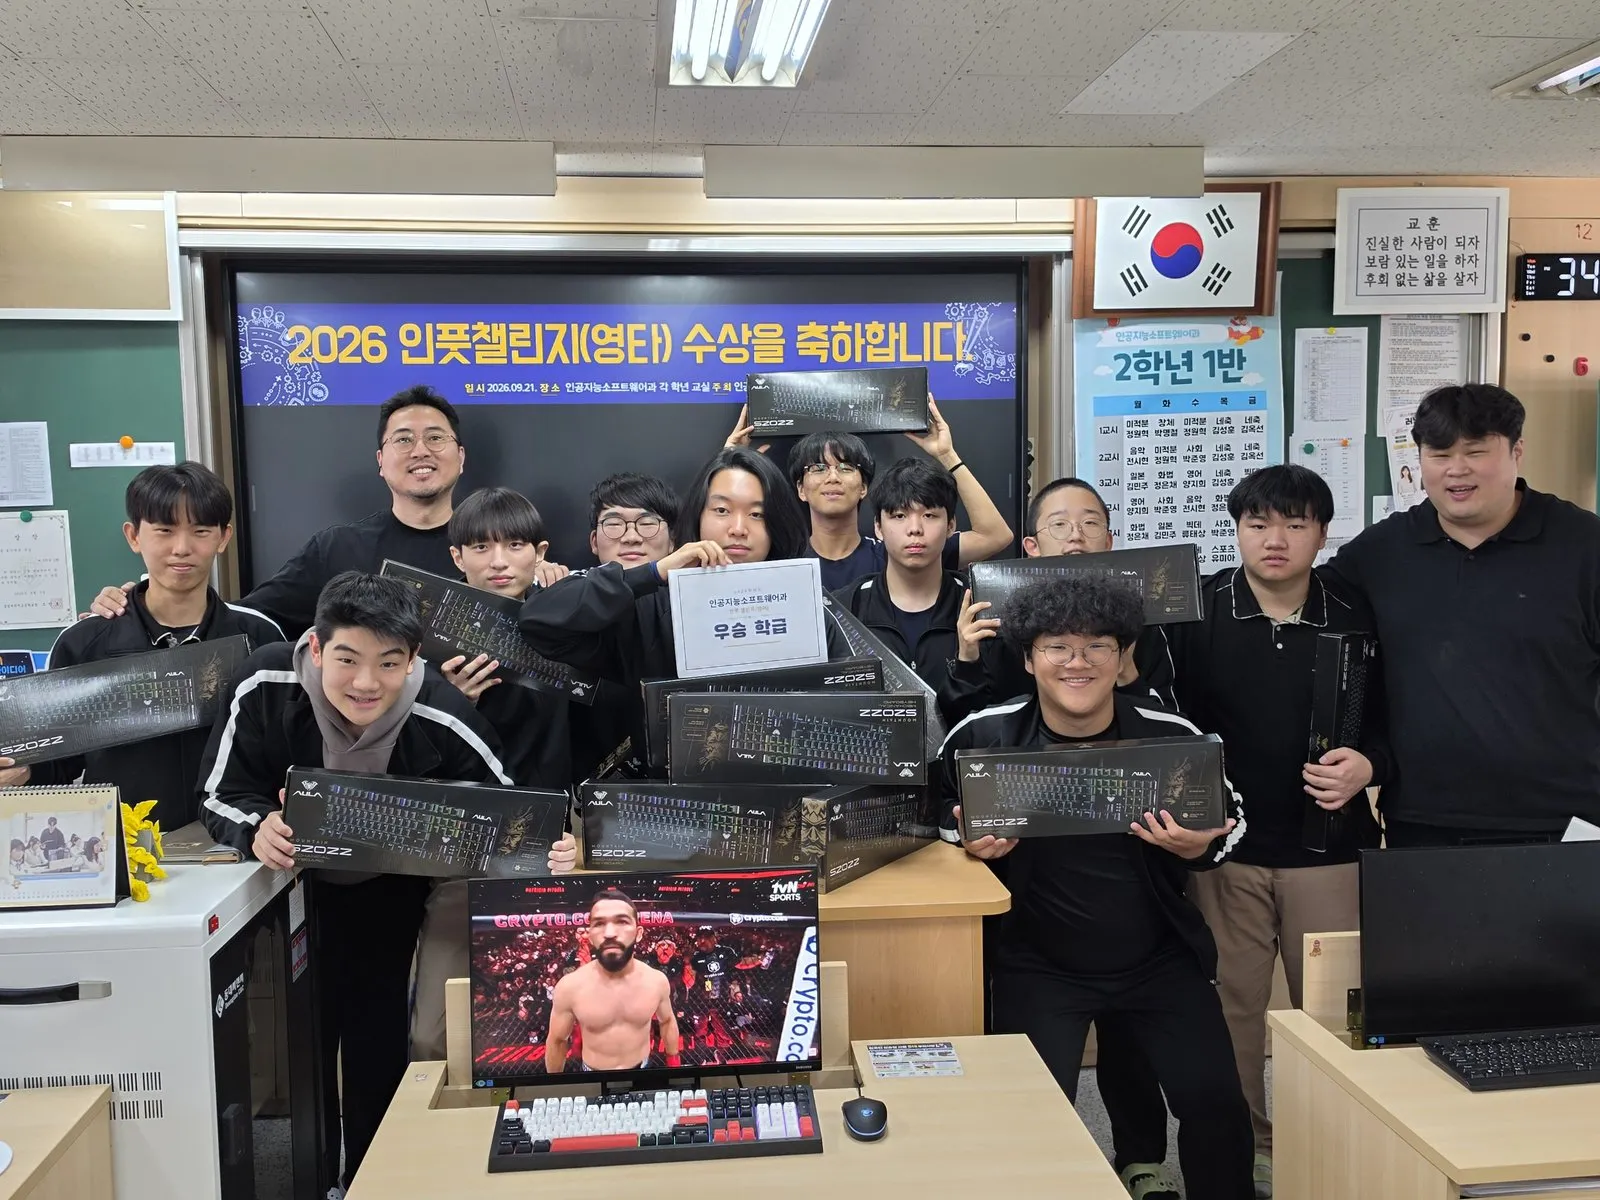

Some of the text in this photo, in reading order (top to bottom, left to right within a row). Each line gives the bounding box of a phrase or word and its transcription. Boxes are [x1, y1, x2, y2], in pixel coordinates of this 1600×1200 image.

[1575, 223, 1593, 240] 12
[1366, 235, 1480, 251] 진실한 사람이 되자
[1365, 253, 1480, 269] 보람 있는 일을 하자
[1364, 271, 1479, 287] 후회 없는 삶을 살자
[1115, 329, 1200, 343] 인공지능소프트웨어과
[287, 321, 967, 365] 2026 인풋챌린지(영타) 수상을 축하합니다
[1113, 348, 1247, 386] 2학년 1반
[1575, 357, 1589, 376] 6
[487, 383, 538, 393] 2026.09.21.
[565, 381, 657, 393] 인공지능소프트웨어과
[659, 382, 669, 393] 각
[671, 381, 689, 393] 학년
[691, 381, 710, 393] 교실
[1162, 399, 1171, 408] 화
[1191, 398, 1200, 406] 수
[1220, 397, 1228, 405] 목
[1248, 396, 1257, 405] 금
[1126, 419, 1149, 428] 미적분
[1183, 417, 1207, 426] 미적분
[1099, 425, 1118, 435] 1교시
[1212, 425, 1235, 435] 김성훈
[1130, 446, 1145, 455] 음악
[1154, 445, 1177, 454] 미적분
[1186, 444, 1203, 453] 사회
[1098, 452, 1120, 462] 2교시
[1182, 454, 1207, 463] 박준영
[1212, 453, 1235, 462] 김성훈
[1130, 471, 1145, 480] 일본
[1158, 471, 1174, 479] 화법
[1186, 469, 1202, 478] 영어
[1099, 478, 1120, 487] 3교시
[1126, 481, 1149, 491] 김민주
[1211, 477, 1235, 487] 김성훈
[1130, 497, 1145, 506] 영어
[1157, 496, 1174, 505] 사회
[1186, 495, 1202, 504] 음악
[1153, 505, 1178, 514] 박준영
[1211, 503, 1227, 512] 정은
[1130, 523, 1146, 531] 화법
[1157, 521, 1173, 530] 일본
[1186, 520, 1202, 529] 빅데
[1215, 519, 1231, 528] 사회
[1154, 530, 1177, 540] 김민주
[1211, 528, 1235, 537] 박준영
[1211, 544, 1236, 553] 스포츠
[708, 593, 788, 608] 인공지능소프트웨어과
[713, 618, 788, 640] 우승 학급
[293, 790, 323, 798] AULA
[472, 814, 492, 822] AULA
[772, 881, 798, 894] tvN
[769, 893, 801, 902] SPORTS
[494, 911, 674, 928] CRYPTO.CO ENA
